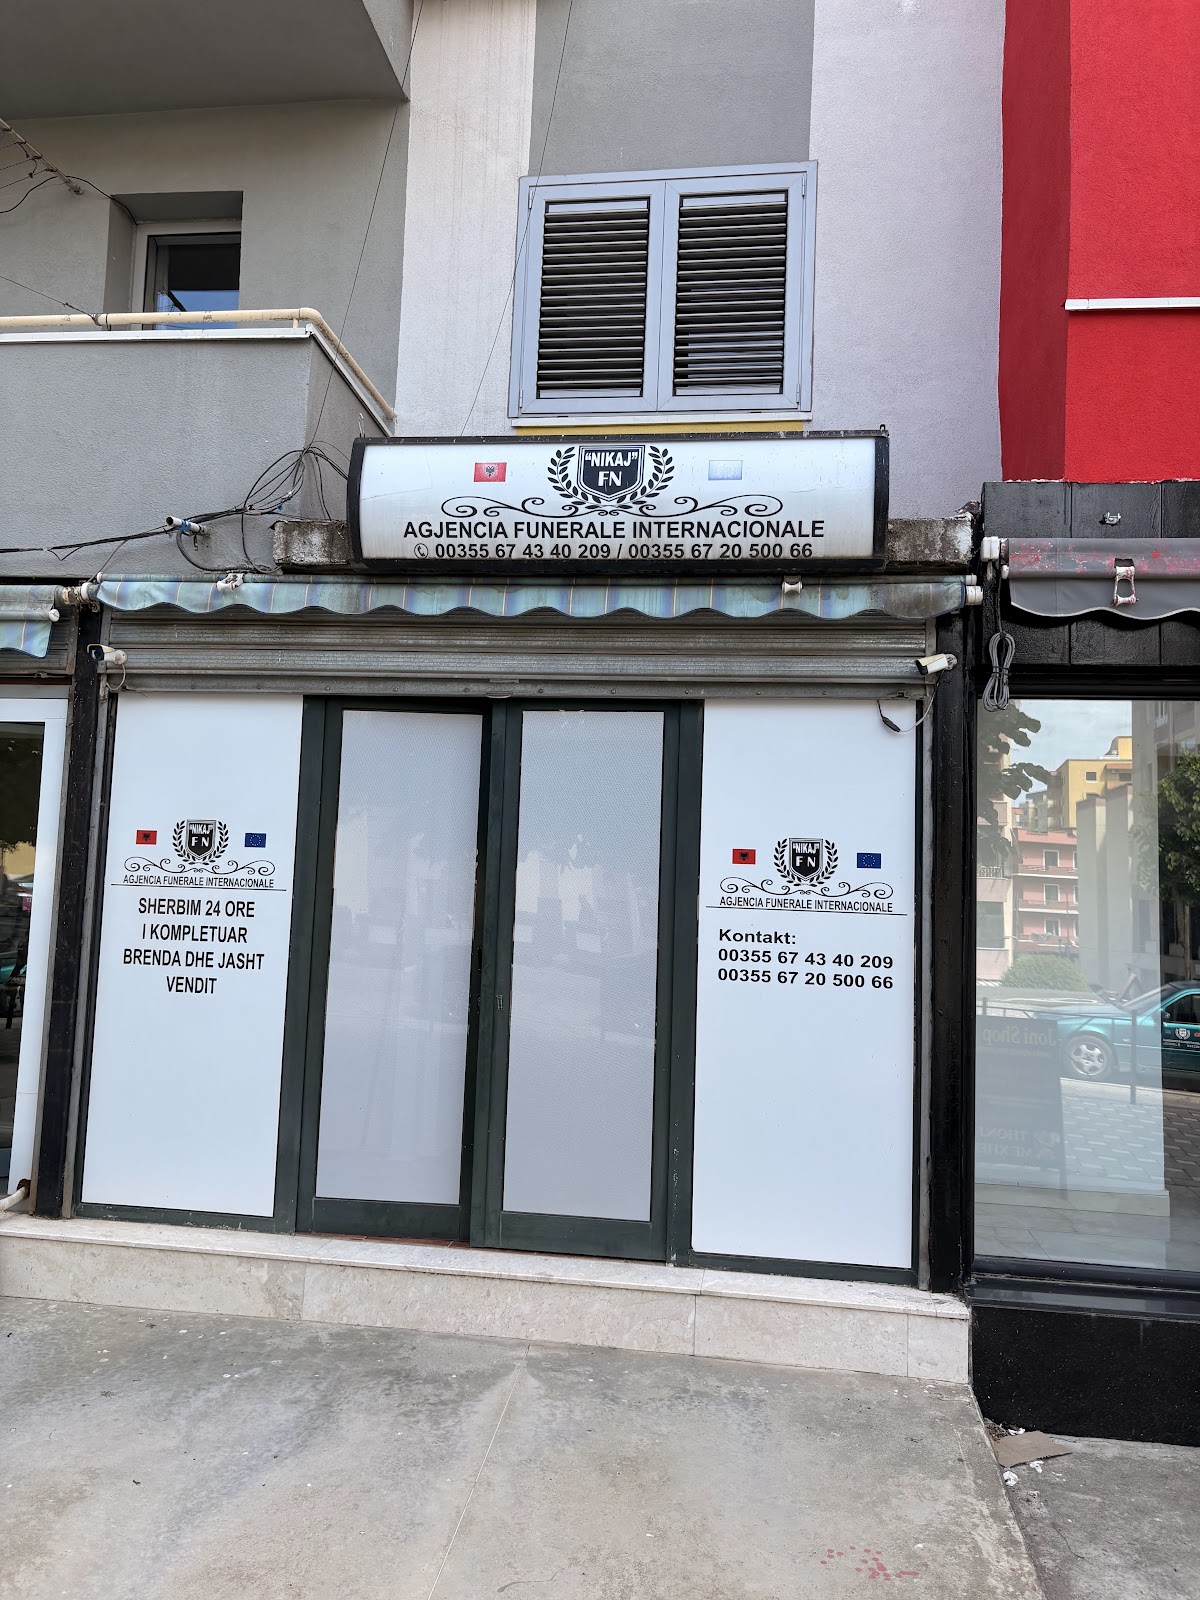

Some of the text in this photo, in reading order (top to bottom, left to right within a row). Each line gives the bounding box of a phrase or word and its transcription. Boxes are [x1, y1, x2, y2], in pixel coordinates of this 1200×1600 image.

[597, 471, 623, 487] FN
[404, 521, 824, 538] AGJENCIA FUNERALE INTERNACIONALE
[434, 544, 491, 560] 00355
[494, 544, 519, 560] 67
[521, 544, 546, 560] 43
[548, 544, 574, 560] 40
[577, 544, 613, 560] 209
[627, 544, 686, 560] 00355
[689, 544, 715, 560] 67
[718, 544, 744, 560] 20
[747, 543, 784, 560] 500
[788, 543, 814, 560] 66
[123, 875, 274, 888] AGJENCIA FUNERALE INTERNACIONALE
[139, 898, 255, 917] SHERBIM 24 ORE
[720, 897, 893, 912] AGJENCIA FUNERALE INTERNACIONALE
[142, 924, 247, 943] I KOMPLETUAR
[720, 929, 795, 944] Kontakt:
[124, 949, 264, 969] BRENDA DHE JASHT
[719, 949, 893, 968] 00355 67 43 40 209
[167, 976, 217, 993] VENDIT
[718, 968, 893, 989] 00355 67 20 500 66
